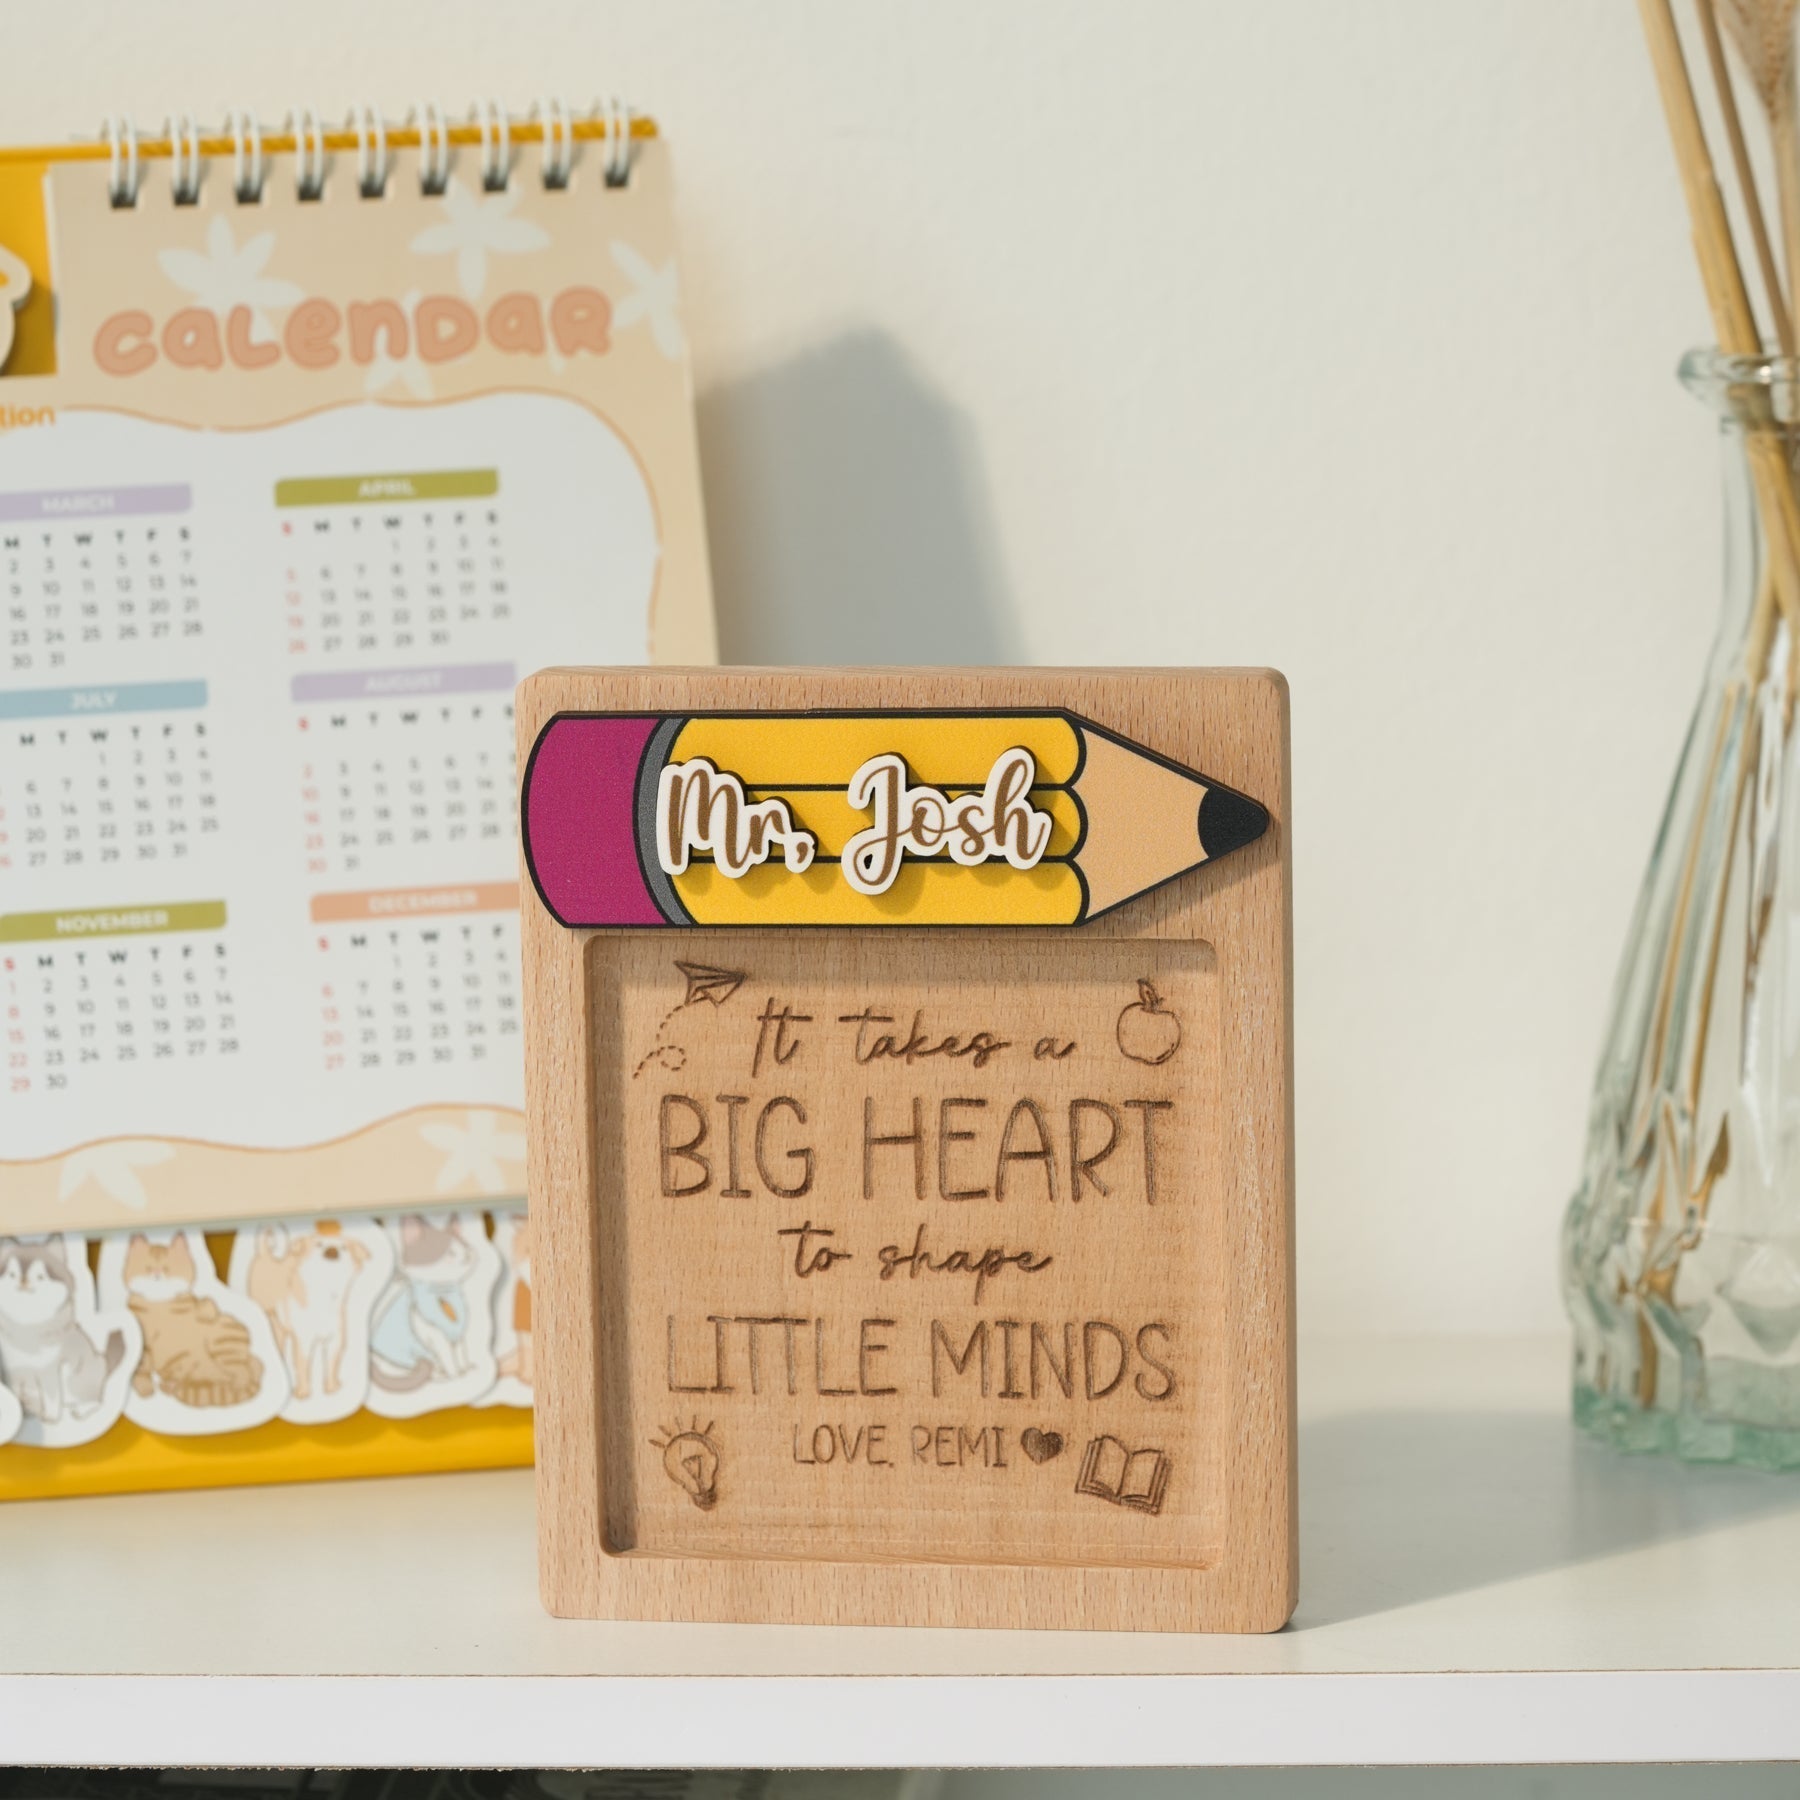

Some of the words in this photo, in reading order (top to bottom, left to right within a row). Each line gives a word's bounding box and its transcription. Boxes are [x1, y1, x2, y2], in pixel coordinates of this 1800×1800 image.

[358, 479, 417, 497] APRIL
[41, 493, 115, 513] MARCH
[365, 672, 442, 691] AUGUST
[71, 691, 117, 710] JULY
[853, 758, 1046, 886] Josh
[368, 891, 477, 913] DECEMBER
[55, 910, 168, 933] NOVEMBER
[36, 954, 55, 970] M
[75, 951, 87, 967] T
[107, 949, 128, 965] W
[149, 946, 161, 962] T
[181, 944, 194, 961] F
[214, 942, 227, 959] S
[752, 997, 813, 1078] It
[838, 1007, 1012, 1066] takes
[1034, 1036, 1075, 1061] a
[659, 1094, 816, 1199] BIG
[863, 1096, 1173, 1205] HEART
[777, 1220, 851, 1279] to
[878, 1223, 1054, 1305] shape
[666, 1315, 899, 1396] LITTLE
[931, 1318, 1178, 1401] MINDS
[911, 1424, 1010, 1469] REMI
